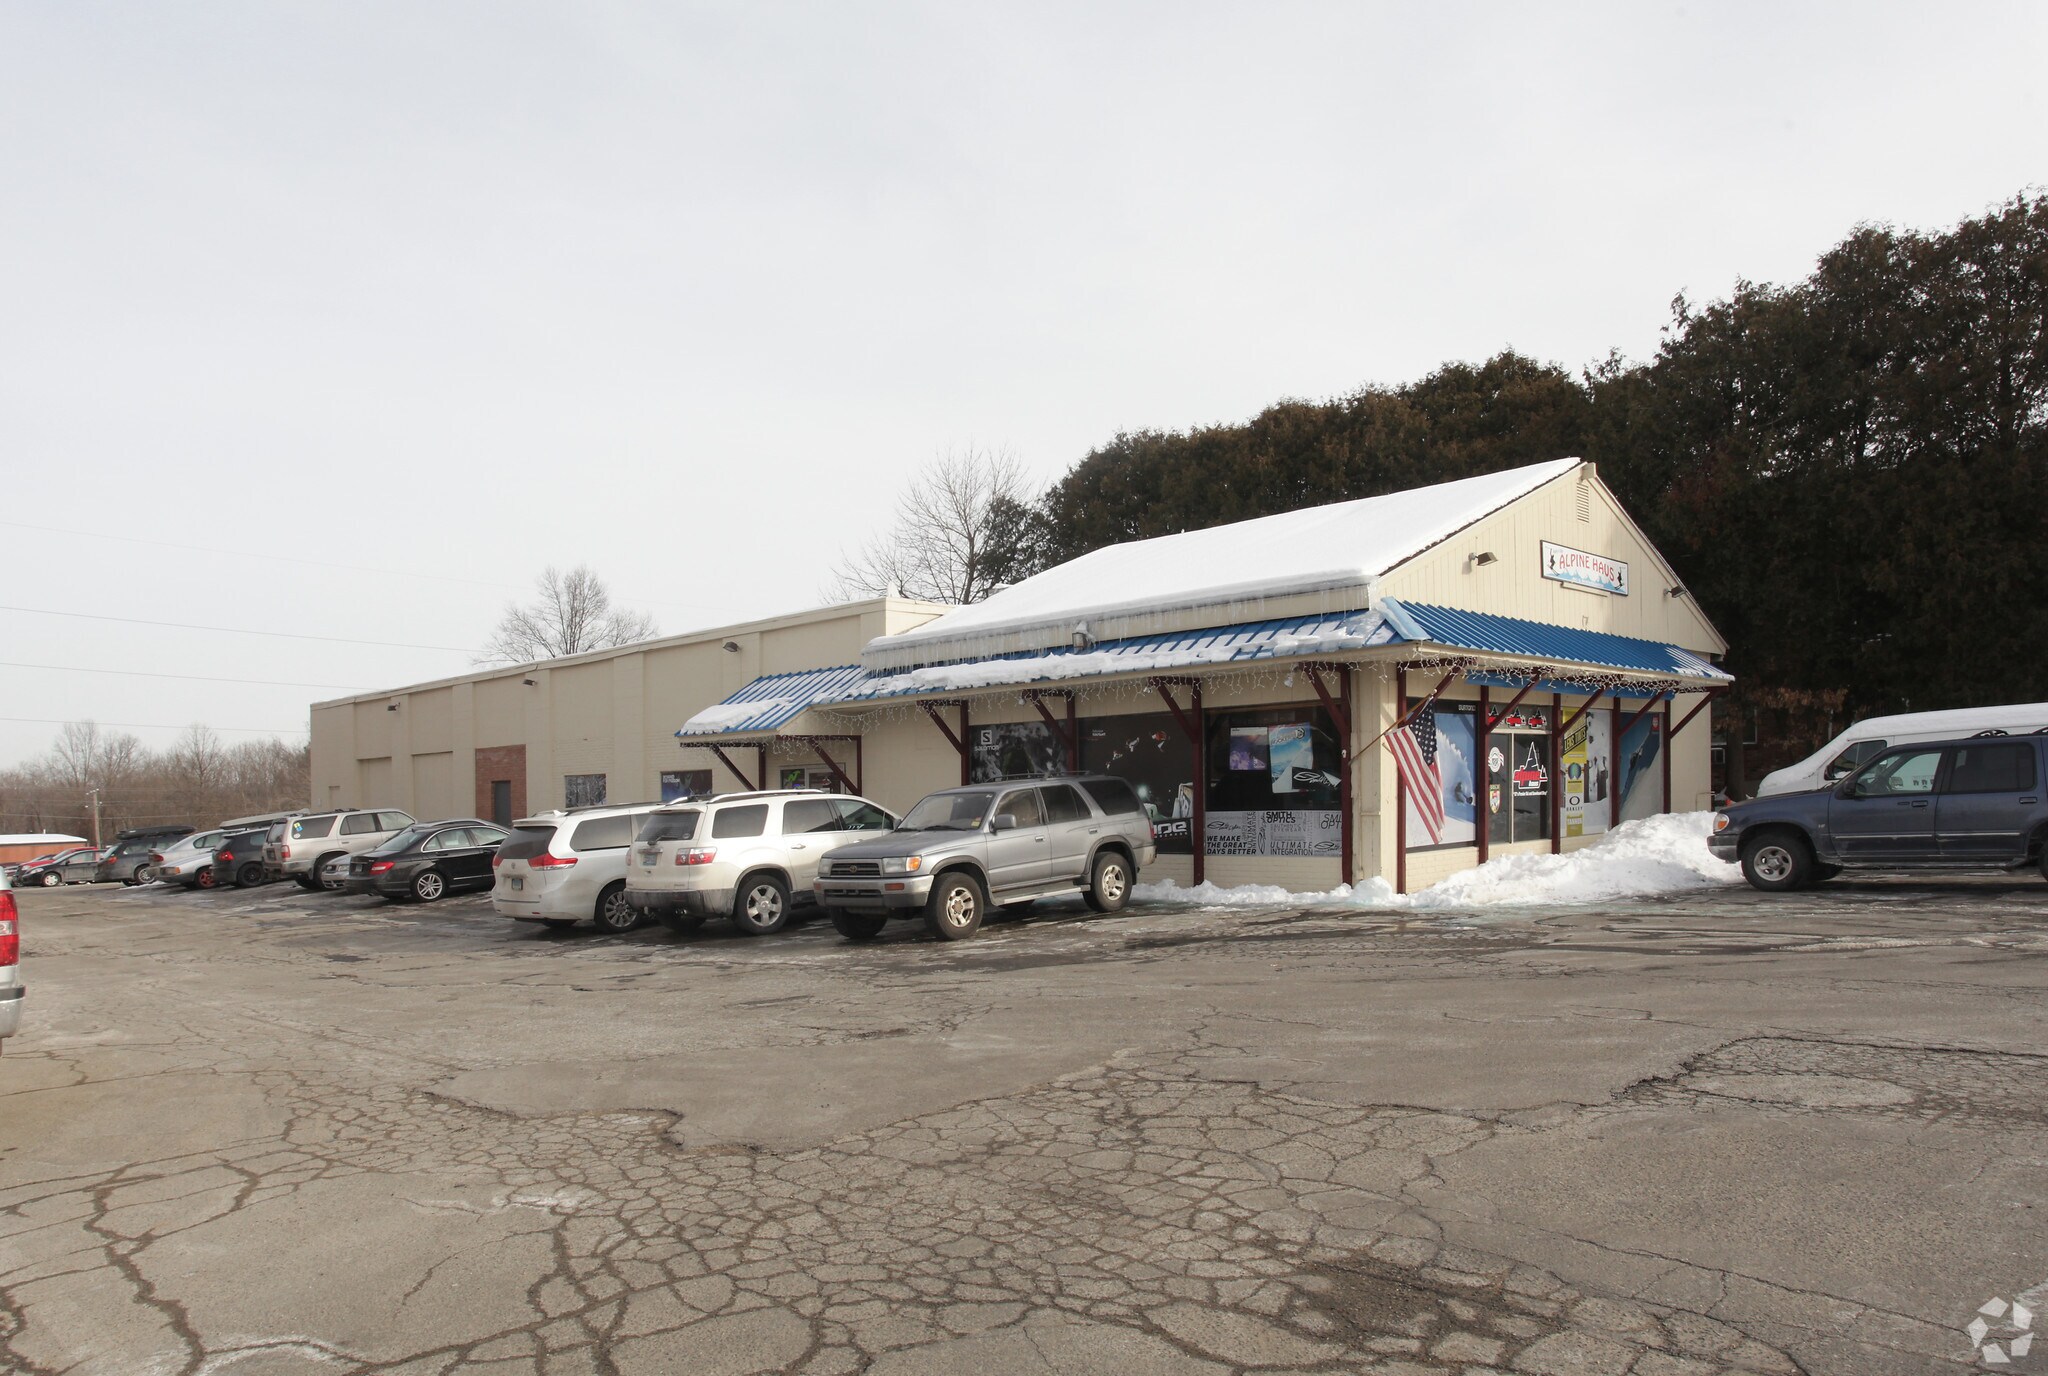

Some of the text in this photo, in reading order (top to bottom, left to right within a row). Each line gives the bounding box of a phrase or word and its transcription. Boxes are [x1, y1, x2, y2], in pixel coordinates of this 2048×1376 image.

[1559, 553, 1615, 582] ALPINE HAUS
[1270, 841, 1313, 849] ULTIMATE
[1270, 848, 1313, 856] INTEGRATION
